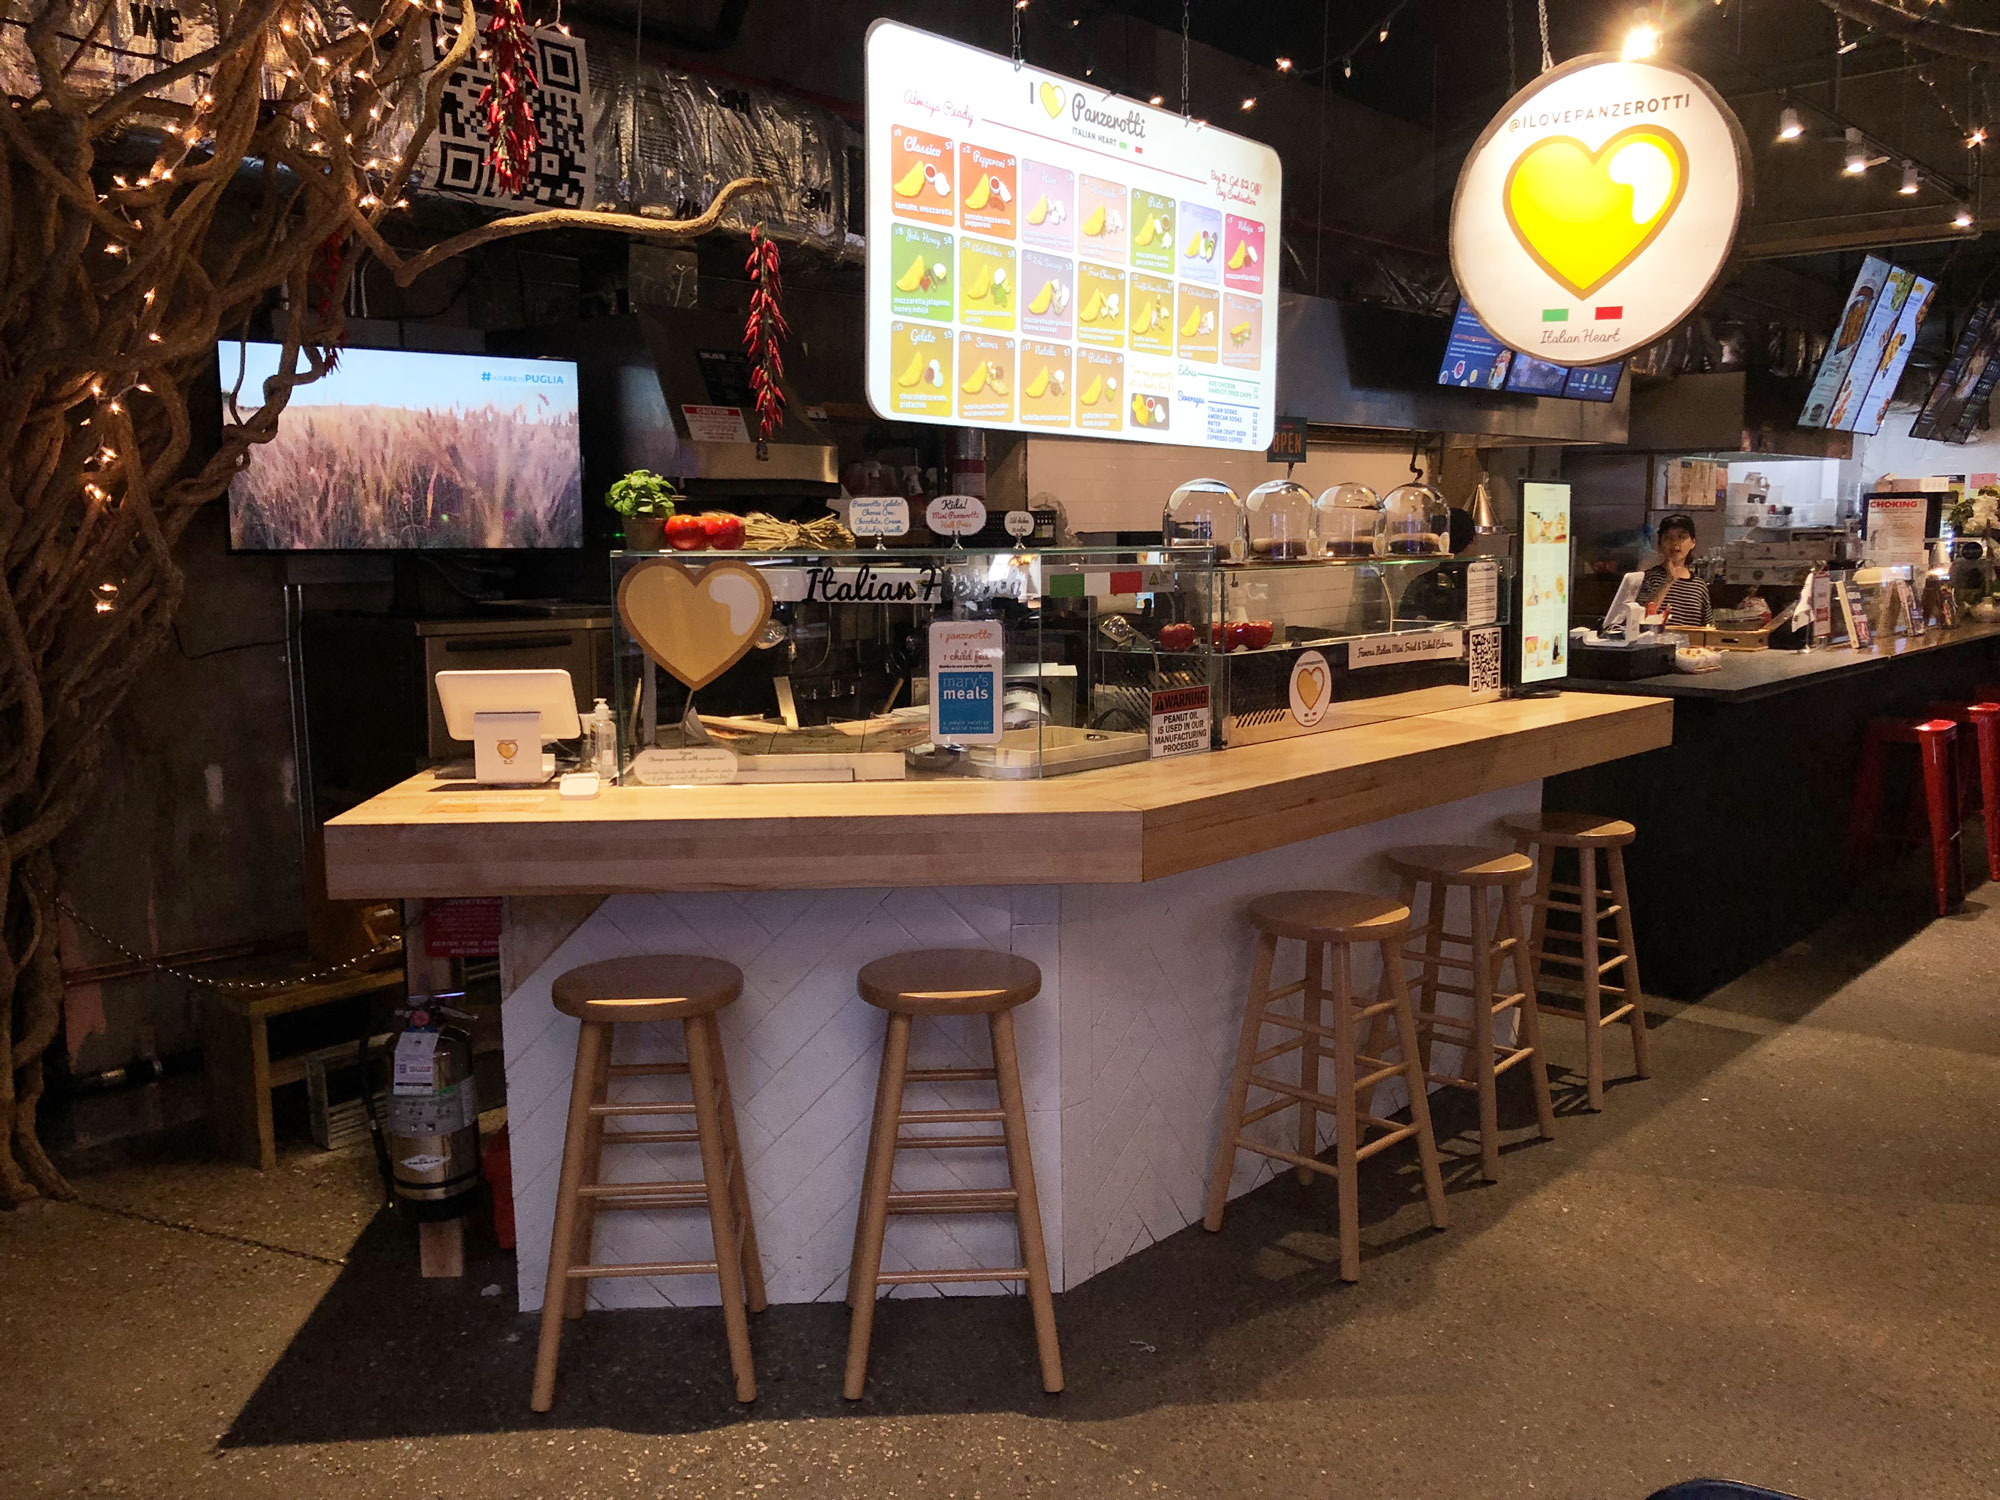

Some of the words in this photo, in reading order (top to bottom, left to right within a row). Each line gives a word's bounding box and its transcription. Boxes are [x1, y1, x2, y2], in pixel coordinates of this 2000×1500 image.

[903, 89, 941, 118] Always
[943, 100, 974, 129] Ready
[1072, 92, 1146, 139] Panzerotti
[1509, 93, 1690, 133] @ILOVEPANZEROTTI
[1072, 126, 1096, 140] ITALIAN
[1097, 134, 1118, 147] HEART
[904, 136, 942, 158] Classico
[973, 150, 1005, 169] Pepperoni
[1211, 169, 1221, 186] Buy
[1229, 176, 1240, 190] Get
[1240, 179, 1249, 190] $2
[1250, 182, 1262, 196] Off!
[1148, 196, 1164, 209] Pesto
[1216, 186, 1227, 202] Any
[1227, 189, 1257, 207] Combination
[895, 201, 919, 212] tomato,
[920, 206, 952, 217] mozzarella
[911, 328, 936, 346] Gelato
[1540, 329, 1580, 345] Italian
[1583, 327, 1621, 344] Heart
[1035, 345, 1057, 357] Nutella
[1178, 364, 1198, 377] Extras
[1177, 390, 1205, 408] Beverages
[1207, 434, 1227, 442] ESPRESSO
[1273, 431, 1303, 454] OPEN
[941, 498, 968, 510] Kids!
[1869, 500, 1918, 508] CHOKING
[931, 511, 948, 520] Mini
[940, 521, 956, 529] Half
[956, 521, 972, 529] Price
[806, 565, 916, 602] Italian
[945, 628, 993, 645] panzerotto
[949, 650, 973, 662] child
[1357, 647, 1375, 658] Famous
[1376, 645, 1391, 656] Italian
[1391, 644, 1404, 653] Mini
[1404, 641, 1417, 653] Fried
[1421, 639, 1436, 651] Baked
[943, 674, 989, 690] mary's
[943, 686, 989, 700] meals
[1164, 690, 1207, 709] WARNING
[1163, 713, 1188, 724] PEANUT
[1189, 711, 1199, 720] OIL
[1158, 726, 1164, 735] IS
[1165, 723, 1183, 734] USED
[1184, 722, 1190, 731] IN
[1191, 719, 1204, 729] OUR
[1154, 729, 1207, 745] MANUFACTURING
[1163, 740, 1199, 753] PROCESSES
